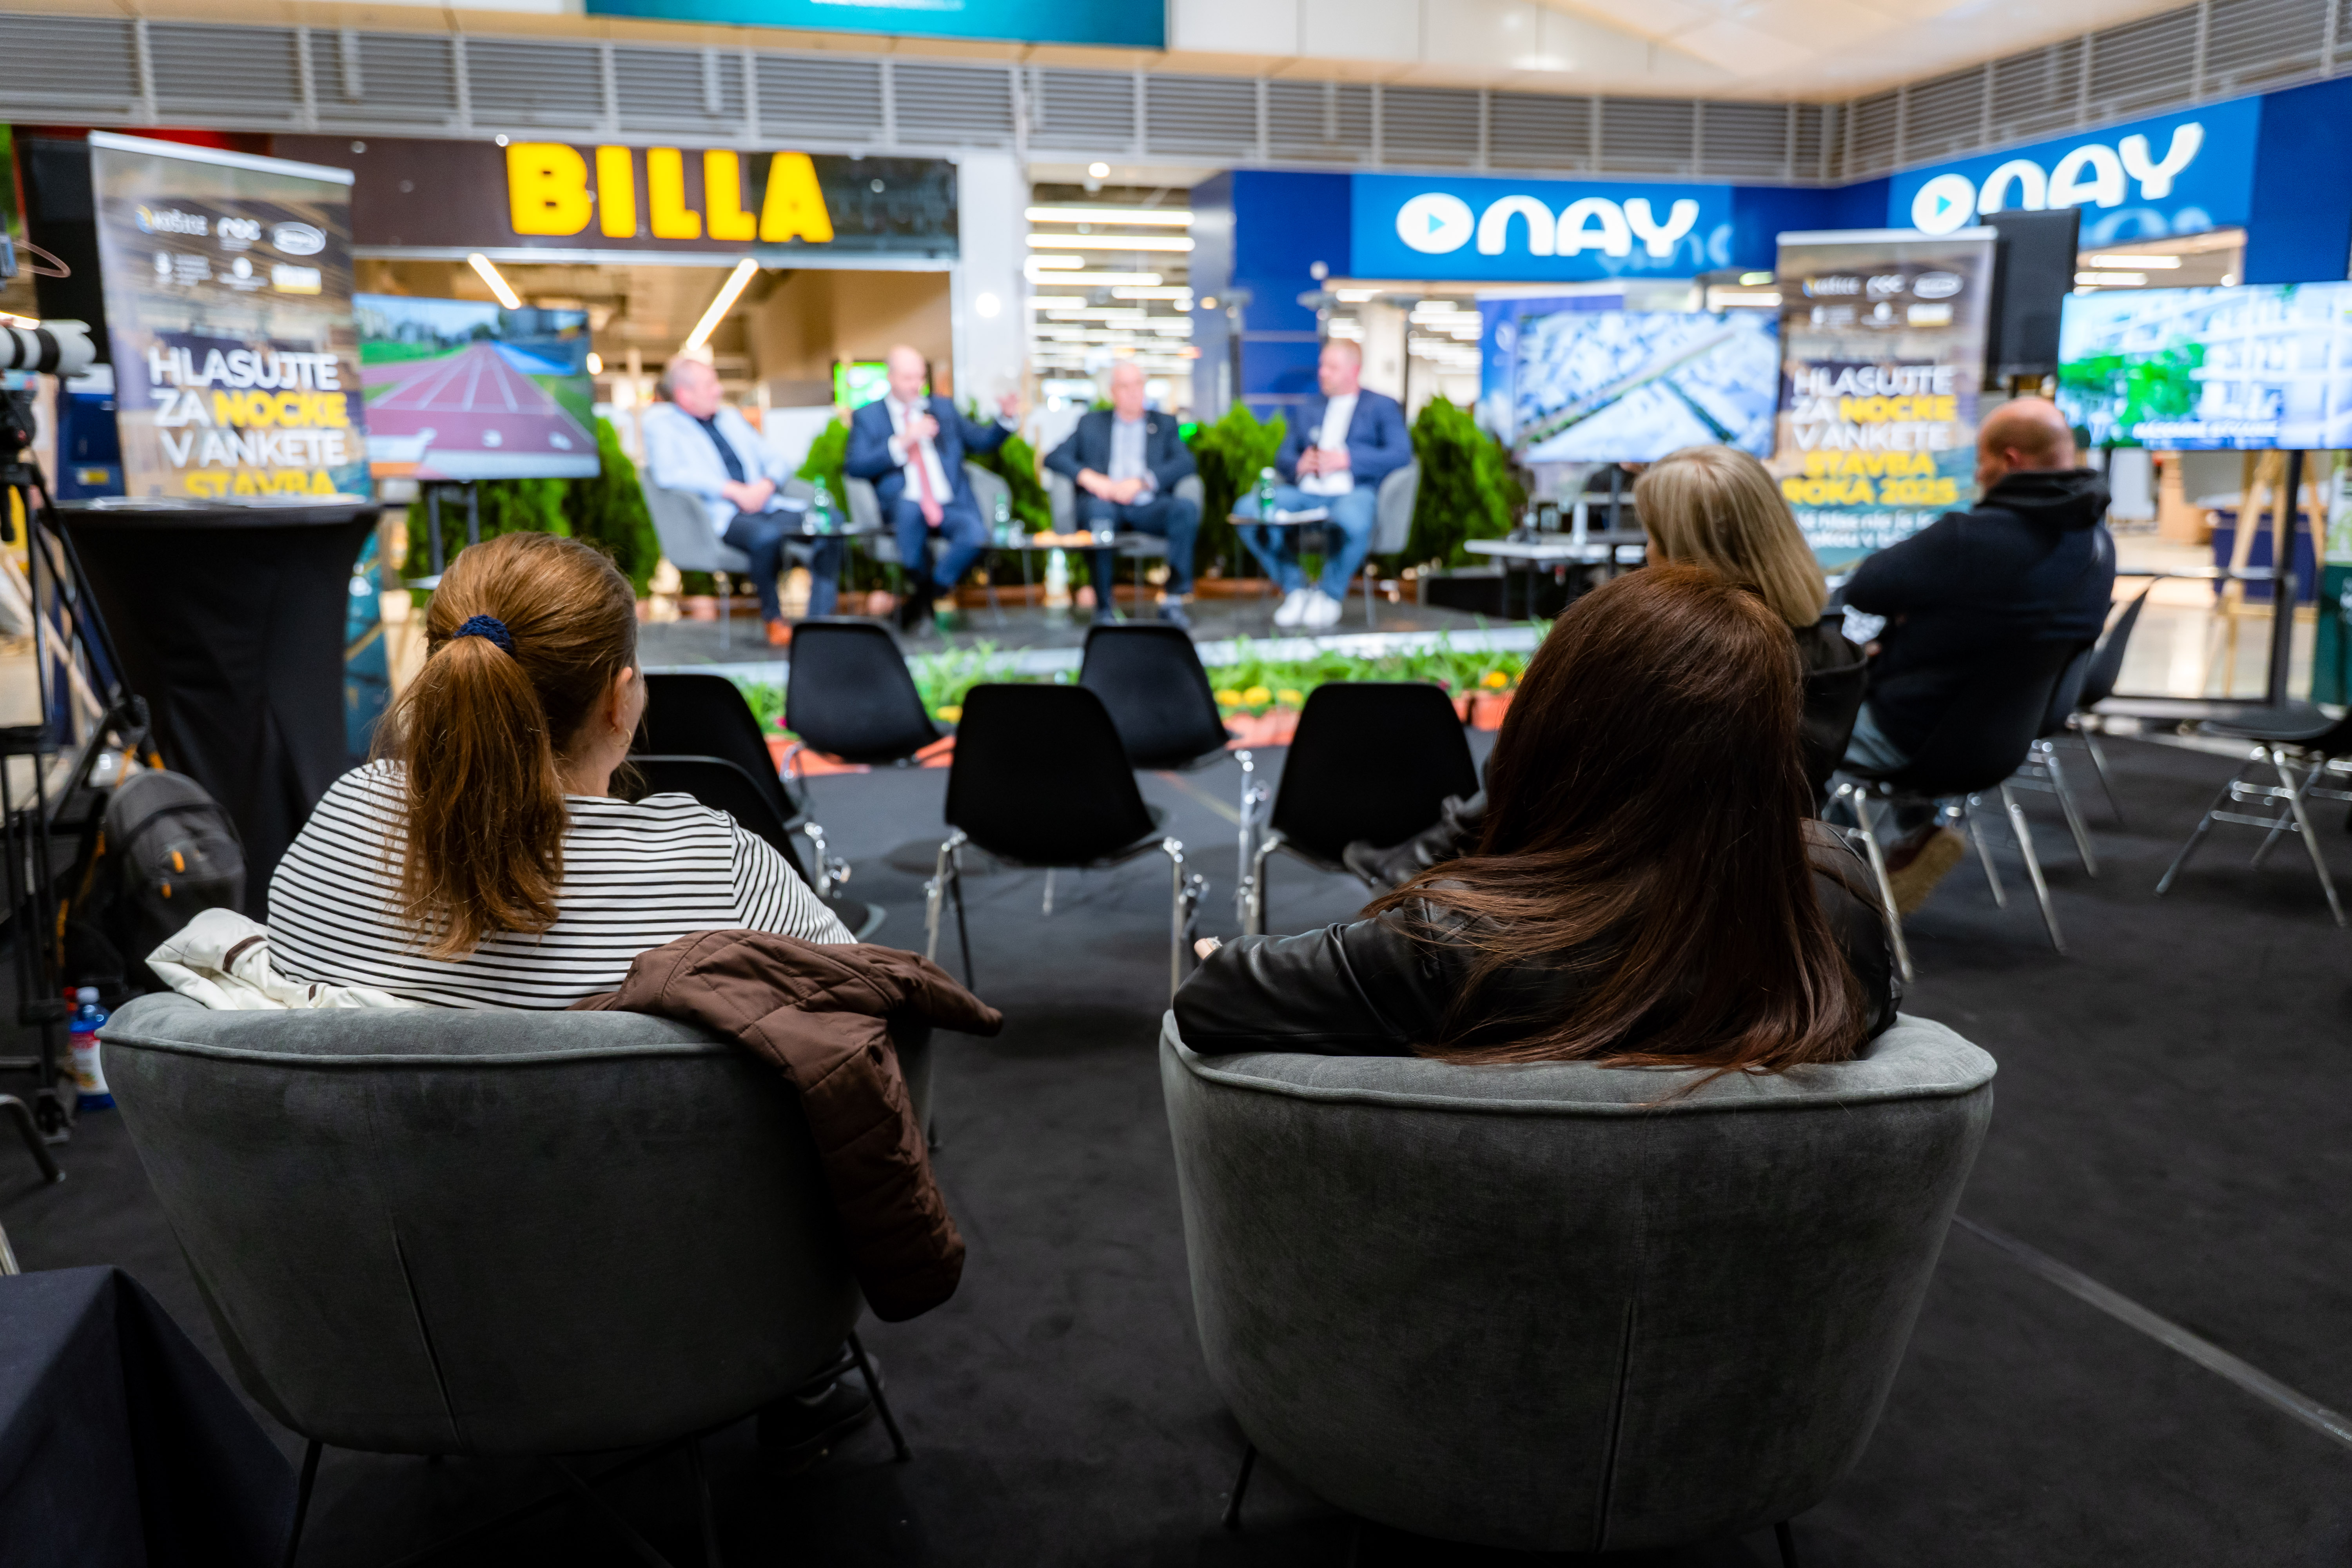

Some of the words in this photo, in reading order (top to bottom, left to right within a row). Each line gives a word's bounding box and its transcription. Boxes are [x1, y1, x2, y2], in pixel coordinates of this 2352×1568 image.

[505, 142, 835, 243] BILLA
[148, 347, 341, 390] HLASUJTE
[1793, 365, 1955, 396] HLASUJTE
[150, 388, 211, 427] ZA
[1790, 395, 1837, 424] ZA
[160, 429, 194, 468] V
[199, 429, 348, 467] ANKETE
[1793, 423, 1818, 451] V
[1820, 422, 1951, 451] ANKETE
